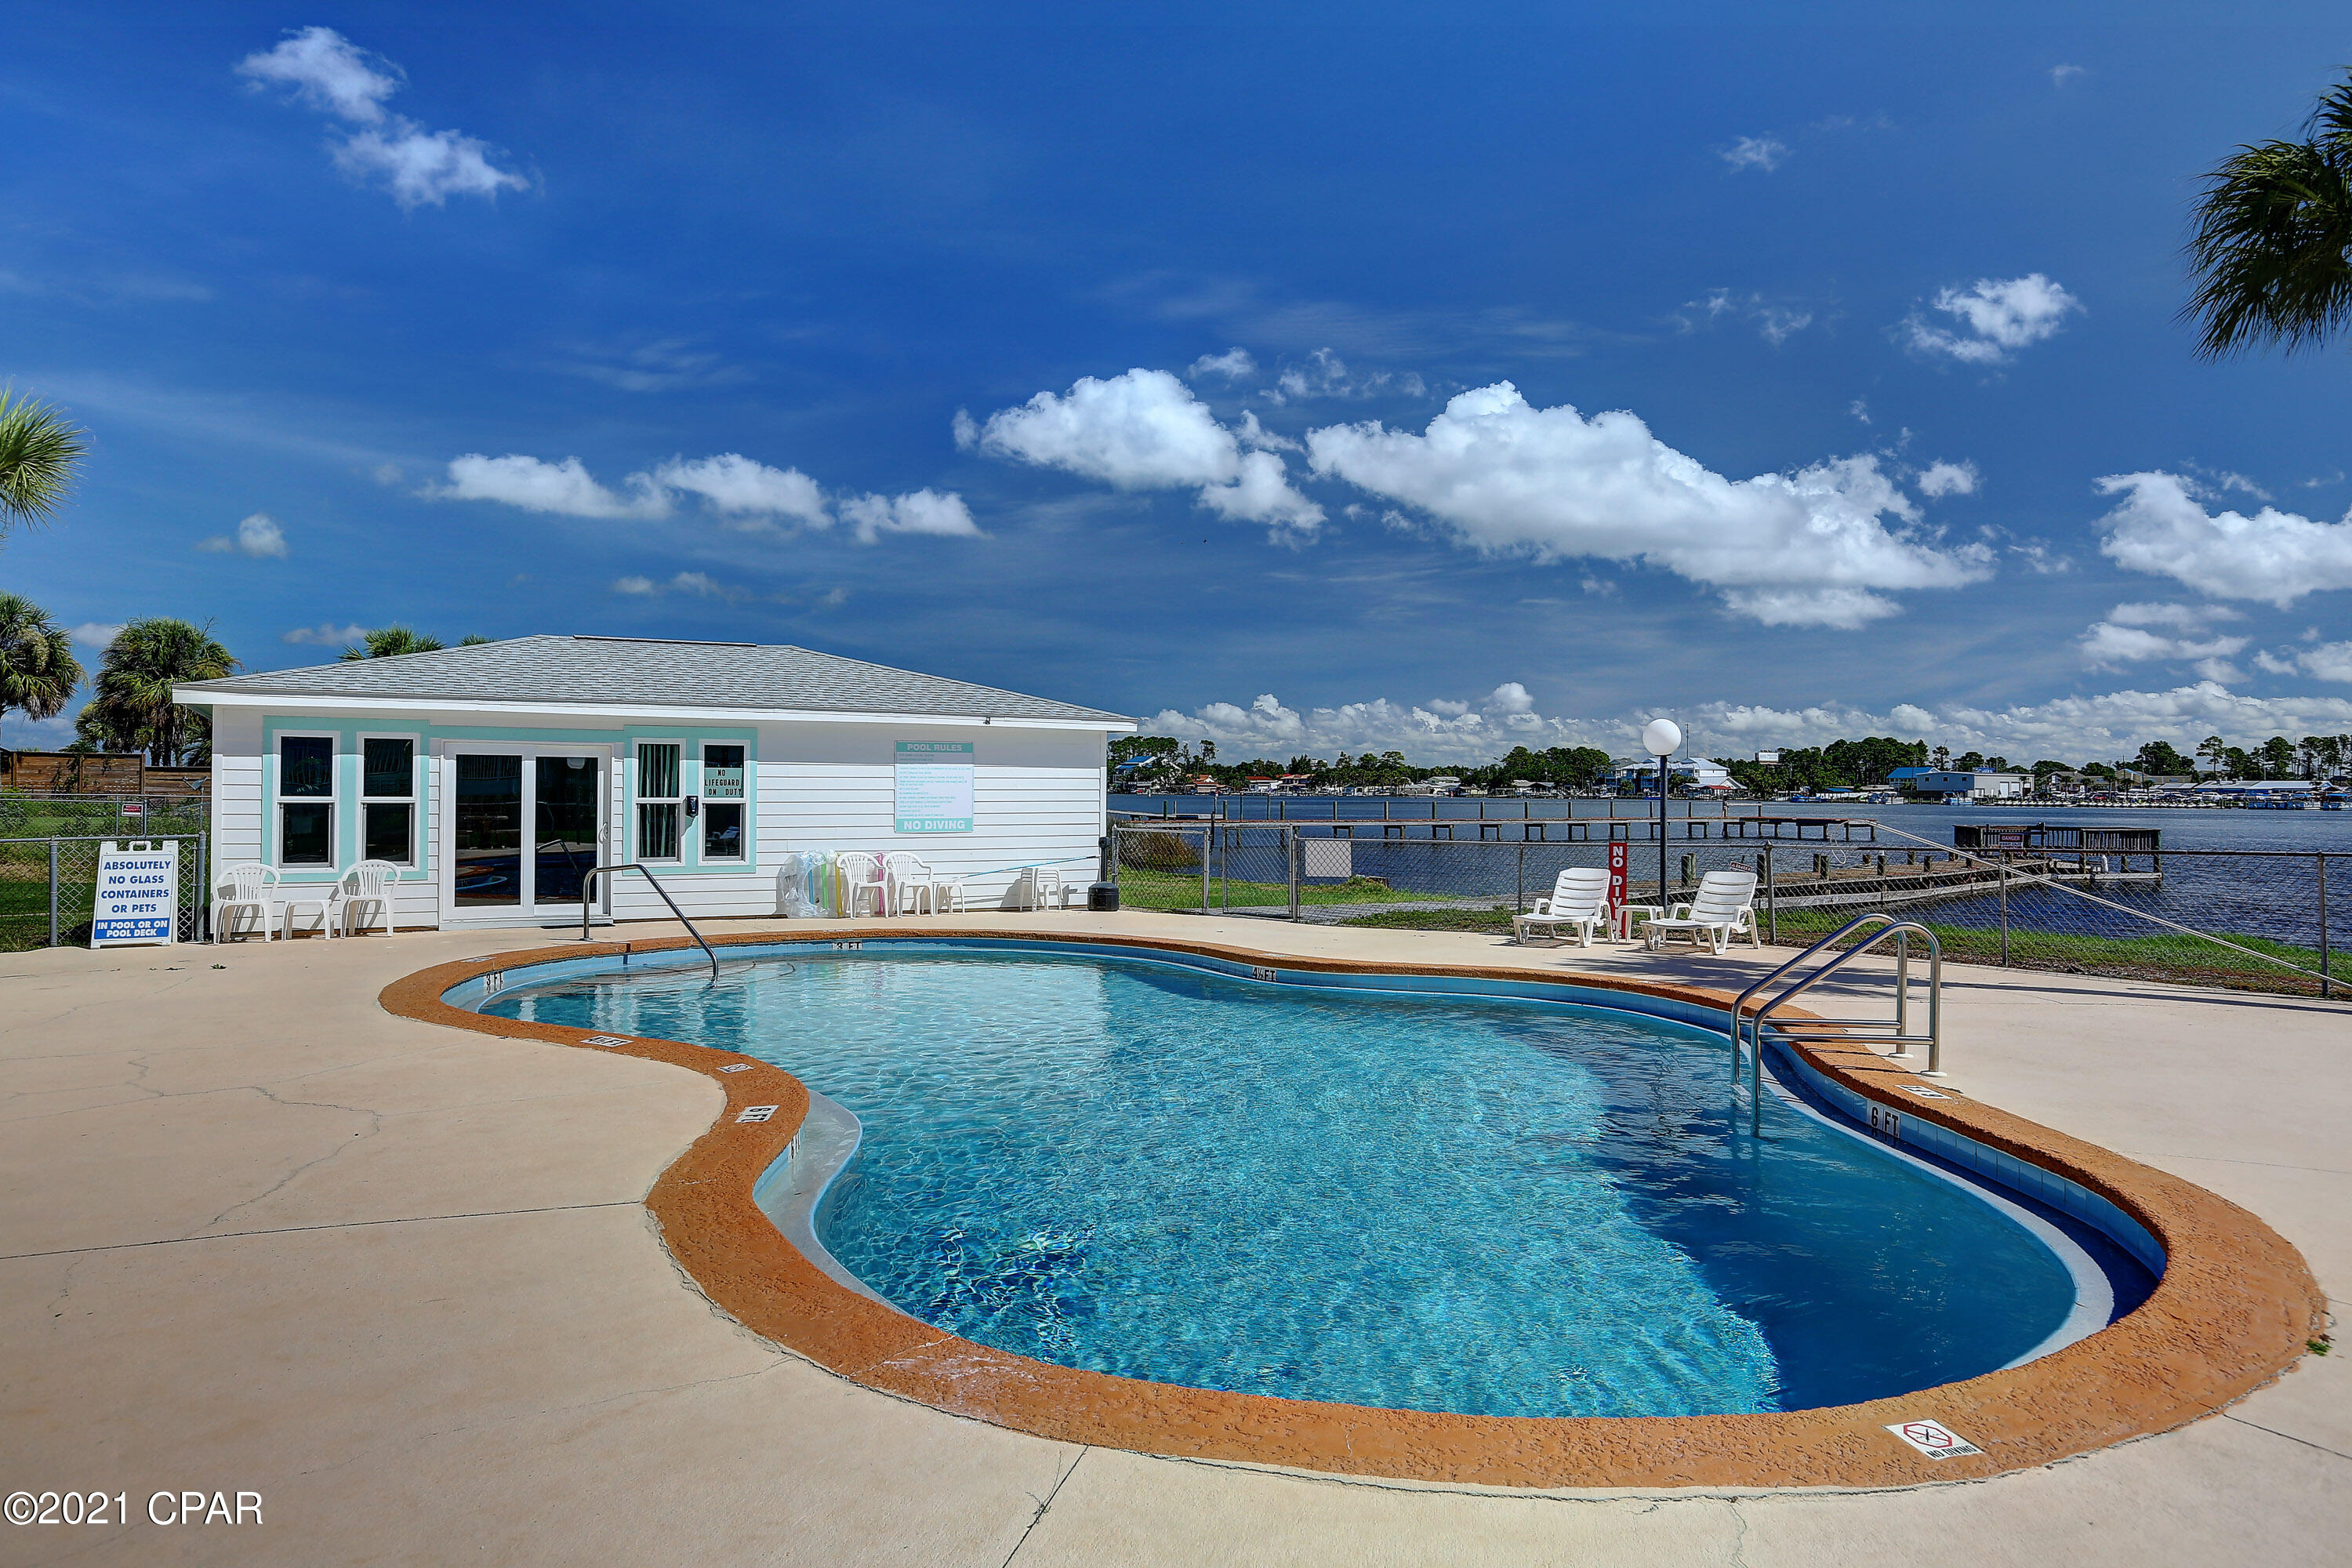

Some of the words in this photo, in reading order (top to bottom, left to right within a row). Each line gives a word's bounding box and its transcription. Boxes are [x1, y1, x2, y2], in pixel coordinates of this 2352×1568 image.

[934, 743, 963, 752] RULES
[903, 820, 921, 830] NO
[925, 820, 965, 829] DIVING
[1612, 846, 1624, 868] NO
[103, 861, 171, 870] ABSOLUTELY
[108, 876, 126, 884] NO
[129, 875, 165, 884] GLASS
[101, 889, 169, 899] CONTAINERS
[111, 904, 128, 913] OR
[132, 903, 157, 913] PETS
[107, 929, 132, 938] POOL
[133, 928, 157, 937] DECK
[1871, 1106, 1878, 1127] 6
[1926, 1450, 1944, 1458] NO
[1941, 1445, 1977, 1456] DIVING
